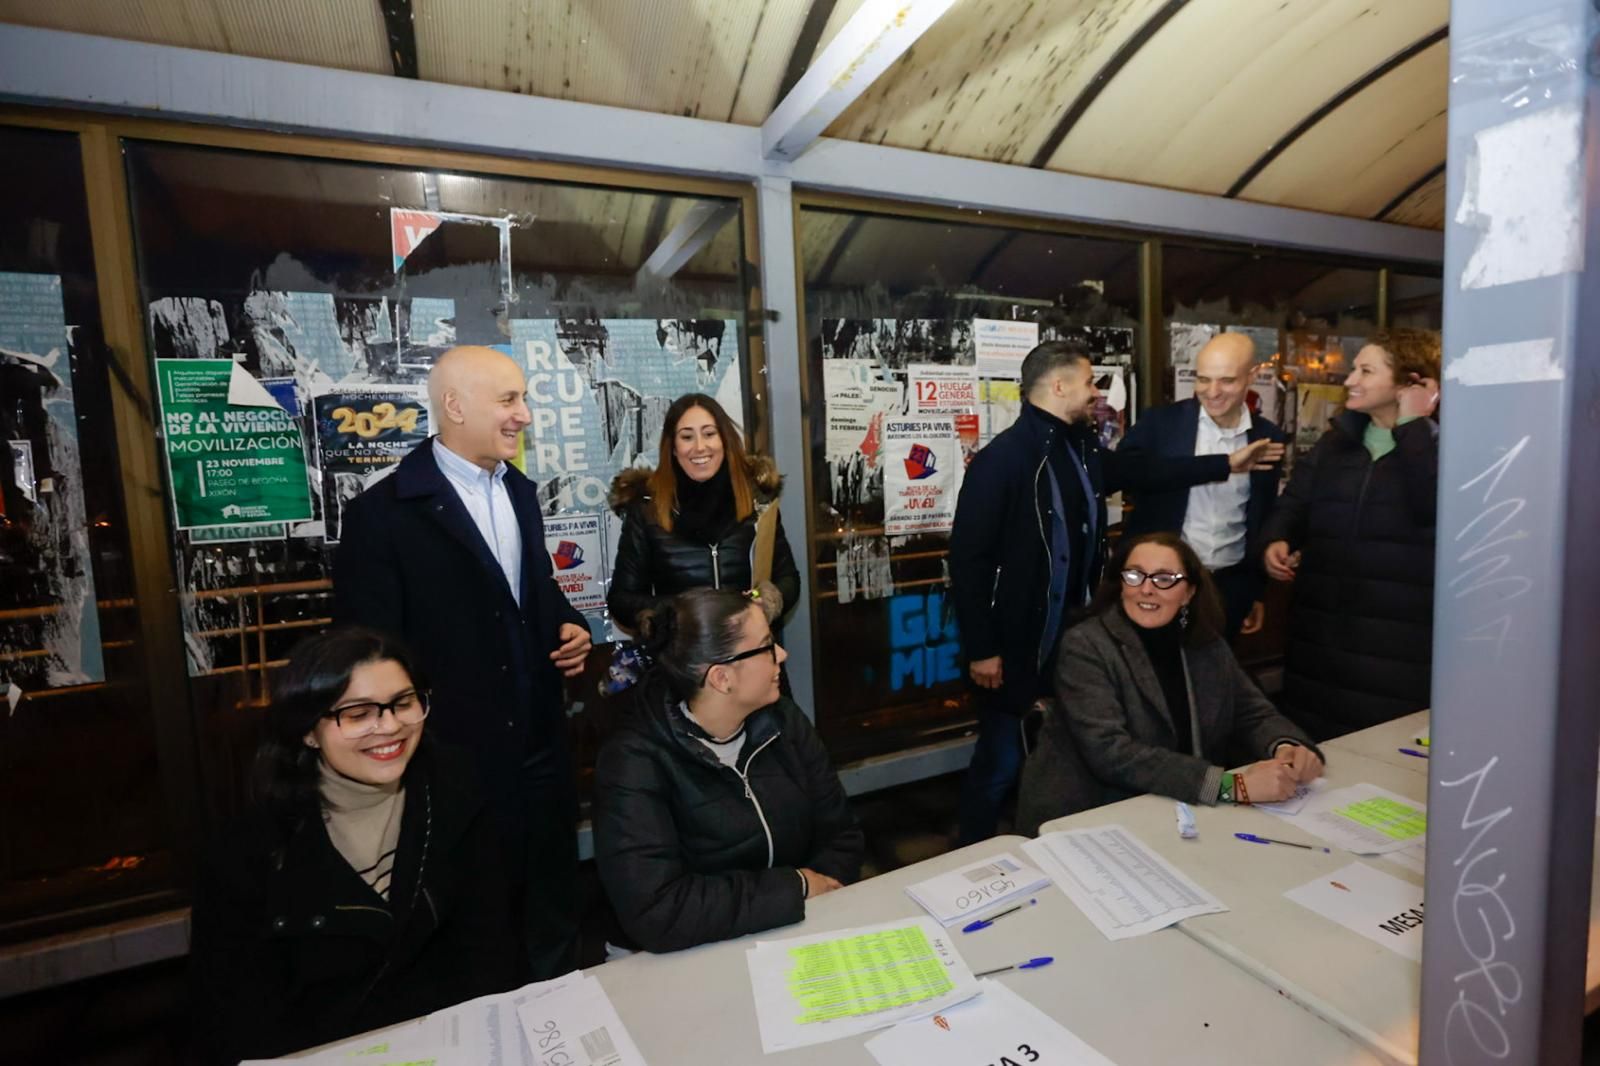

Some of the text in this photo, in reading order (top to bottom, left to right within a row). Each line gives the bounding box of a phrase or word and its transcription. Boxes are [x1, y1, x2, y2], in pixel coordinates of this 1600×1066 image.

[528, 372, 584, 404] CU
[916, 381, 937, 400] 12
[939, 391, 976, 399] GENERAL
[167, 412, 193, 423] NO
[199, 411, 220, 422] AL
[332, 403, 418, 437] 2024
[532, 406, 585, 439] PE
[169, 420, 298, 435] DE LA VIVIENDA
[887, 423, 921, 432] ASTURIES
[170, 433, 301, 453] MOVILIZACIÓN
[206, 457, 285, 468] 23 NOVIEMBRE
[535, 442, 589, 473] RE
[206, 468, 233, 477] 17:00
[1016, 1043, 1041, 1063] 3
